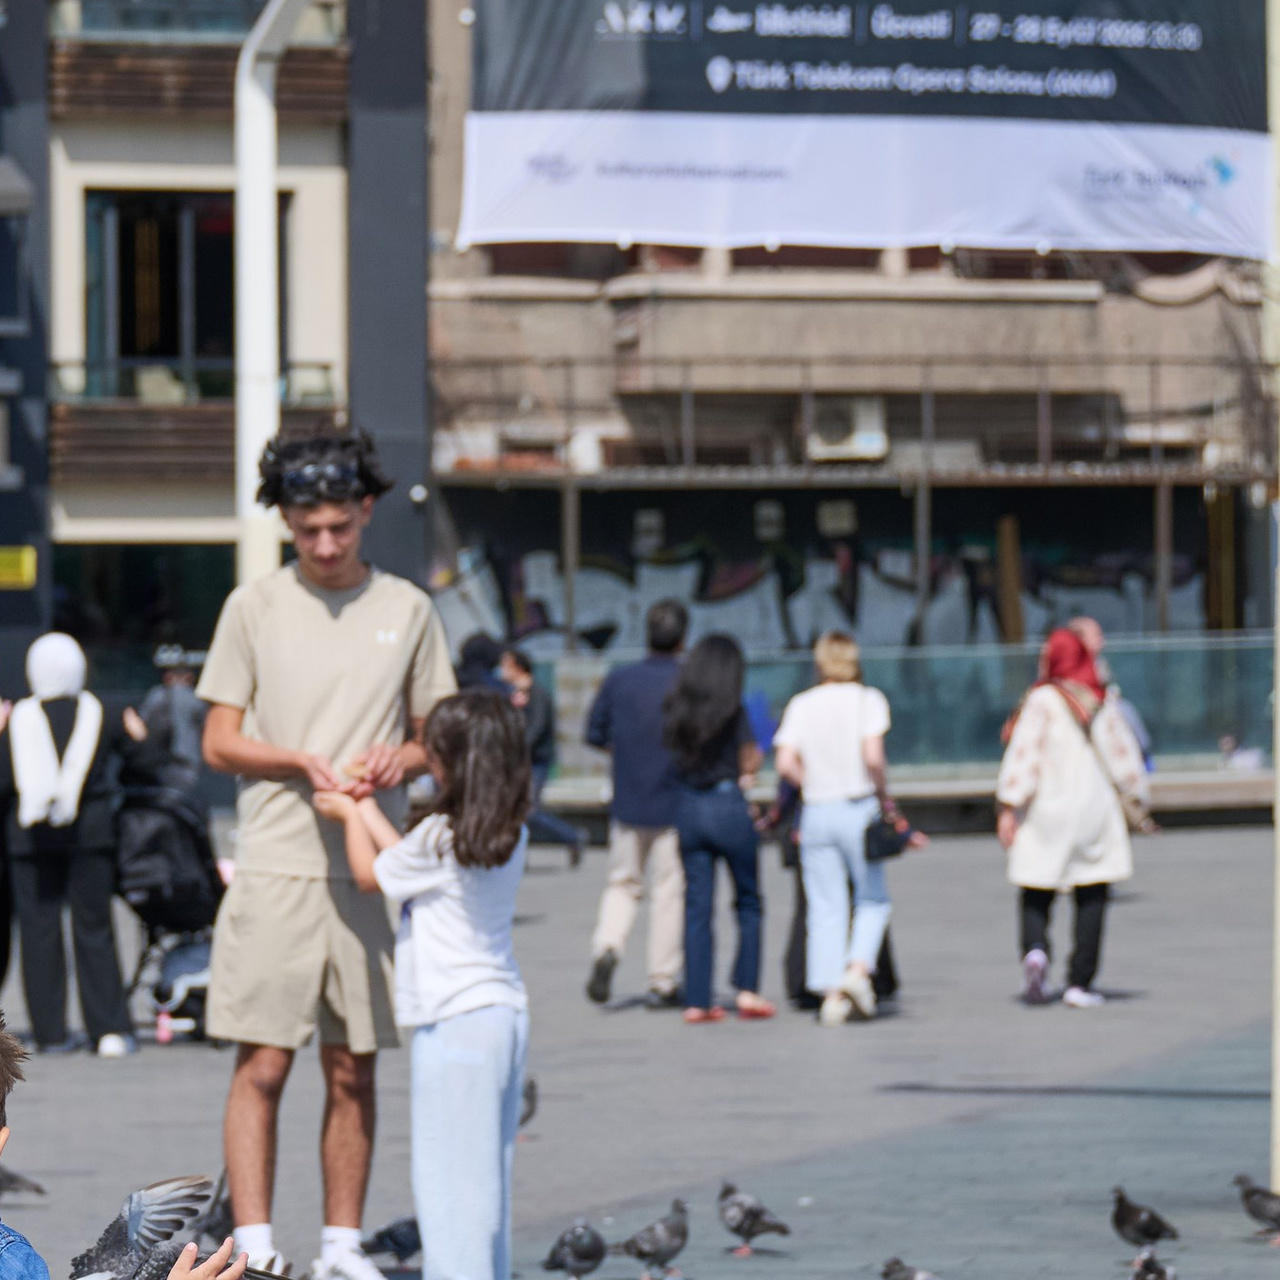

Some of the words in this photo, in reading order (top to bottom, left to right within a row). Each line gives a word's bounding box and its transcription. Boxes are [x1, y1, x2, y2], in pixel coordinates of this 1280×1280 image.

[735, 60, 790, 90] Türk
[792, 61, 892, 90] Telekom
[893, 63, 965, 95] Opera
[967, 65, 1045, 96] Salonu
